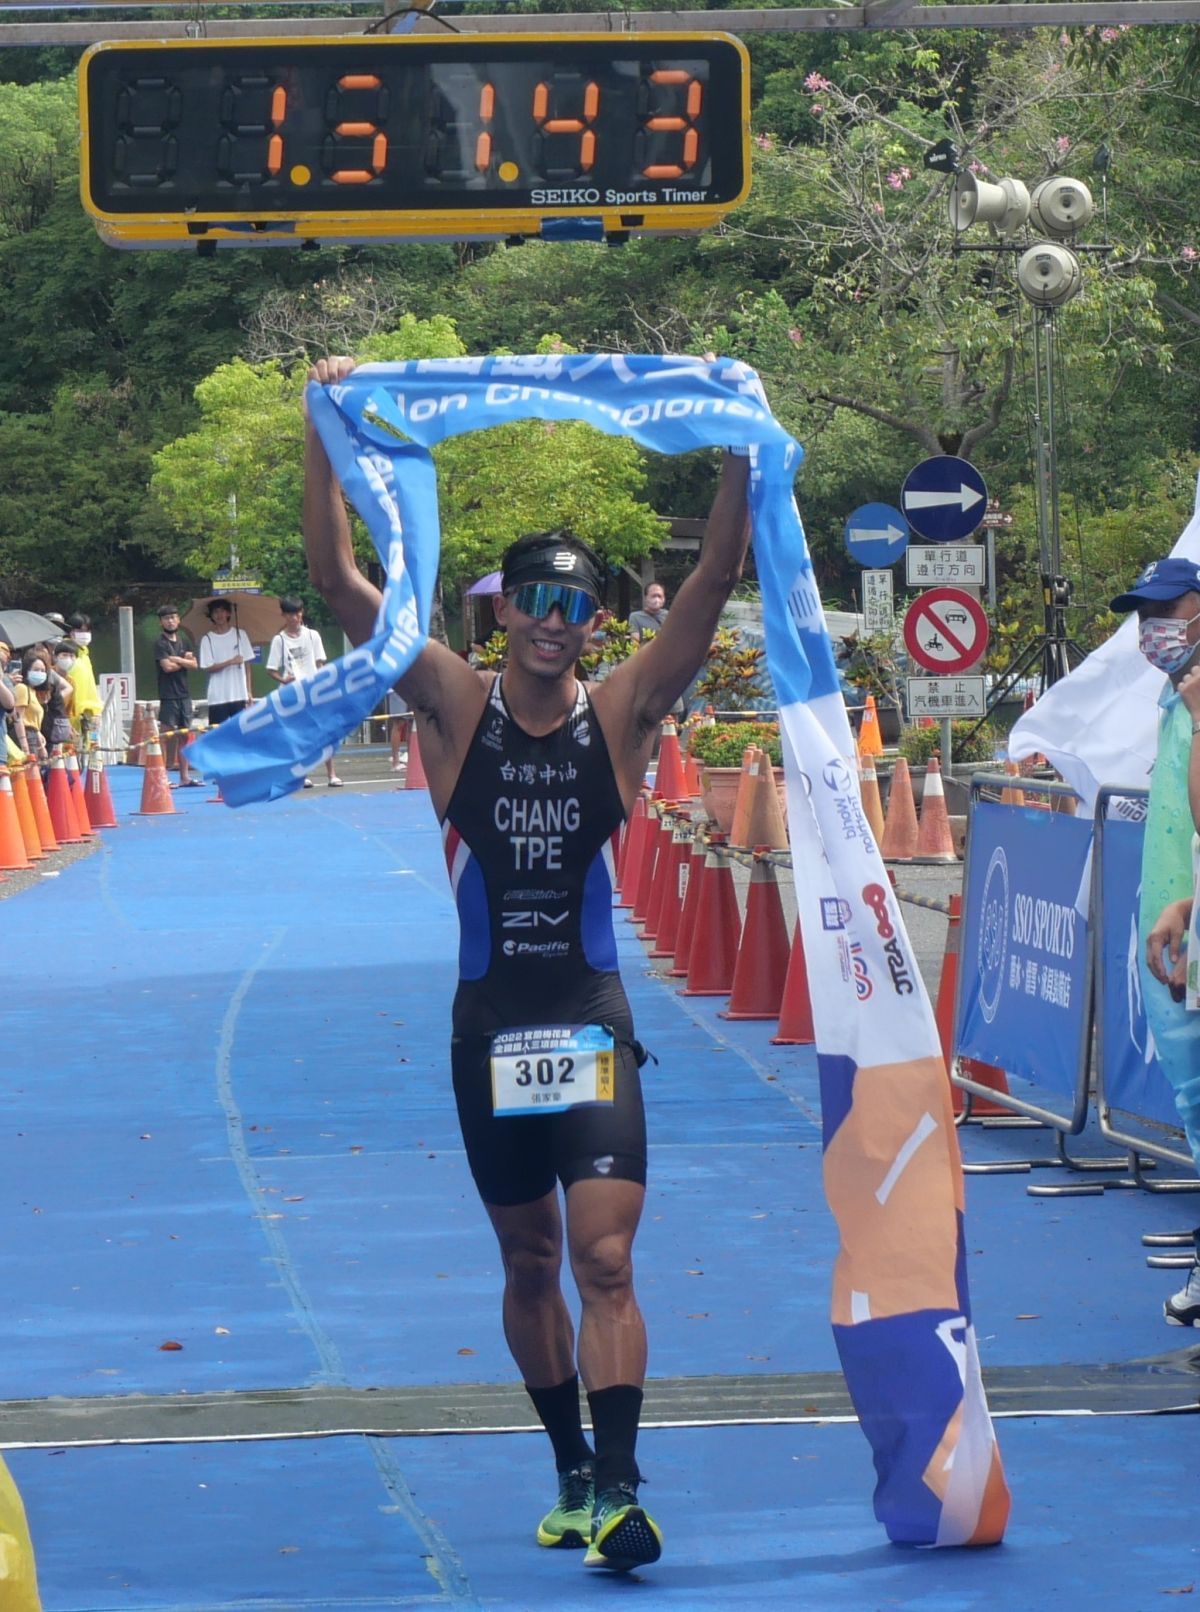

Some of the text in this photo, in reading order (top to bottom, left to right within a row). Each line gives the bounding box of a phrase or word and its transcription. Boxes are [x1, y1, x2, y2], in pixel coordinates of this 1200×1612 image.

[530, 187, 707, 204] SEIKO Sports Timer
[924, 550, 967, 562] 單行道
[916, 563, 976, 576] 遵行方向
[239, 649, 376, 735] 2022
[928, 681, 966, 694] 禁止
[914, 694, 979, 707] 汽機車進入
[500, 760, 578, 785] 台灣中油
[494, 796, 580, 831] CHANG
[510, 836, 563, 870] TPE
[502, 910, 569, 928] ZIV
[1012, 892, 1076, 960] SSO SPORTS
[517, 941, 570, 952] Pacific
[515, 1056, 575, 1087] 302
